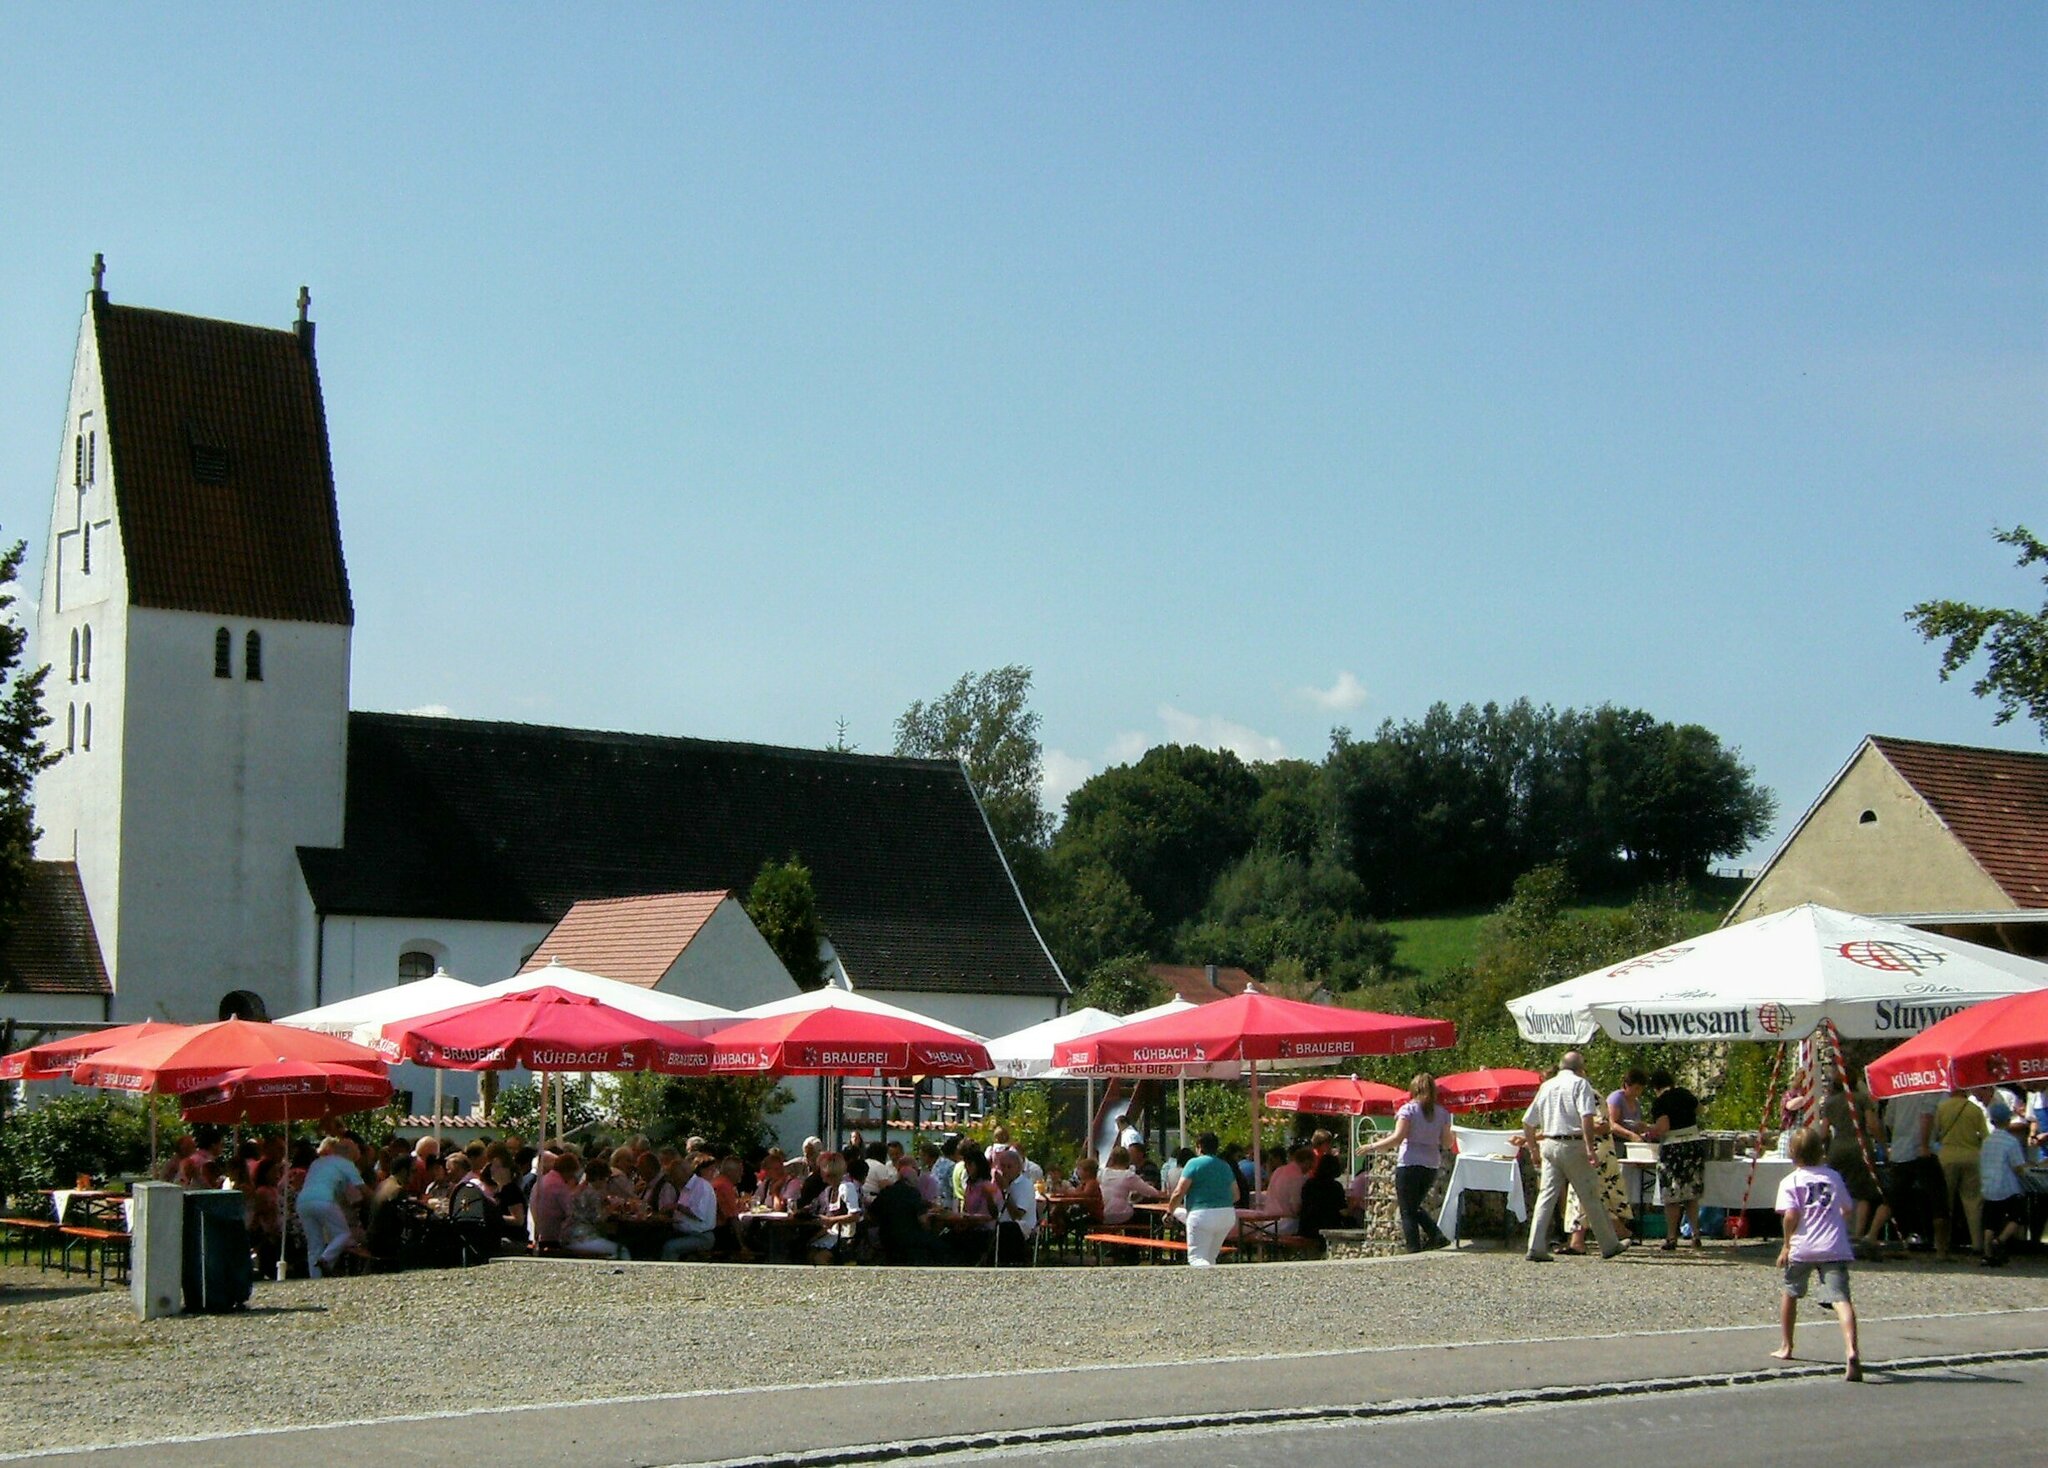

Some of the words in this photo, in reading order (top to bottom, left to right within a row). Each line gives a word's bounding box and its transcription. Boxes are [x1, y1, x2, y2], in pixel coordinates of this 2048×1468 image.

[1525, 1005, 1576, 1040] Stuyvesant
[1617, 1004, 1751, 1040] Stuyvesant
[442, 1046, 506, 1062] BRAUEREI
[1133, 1047, 1189, 1061] KÜHBACH
[1295, 1041, 1354, 1054] BRAUEREI
[533, 1048, 608, 1064] KÜHBACH
[667, 1052, 709, 1067] BRAUEREI
[713, 1051, 756, 1066] ÜHBACH
[822, 1051, 889, 1065] BRAUEREI
[1146, 1064, 1174, 1075] BIER
[1892, 1071, 1937, 1089] KÜHBACH
